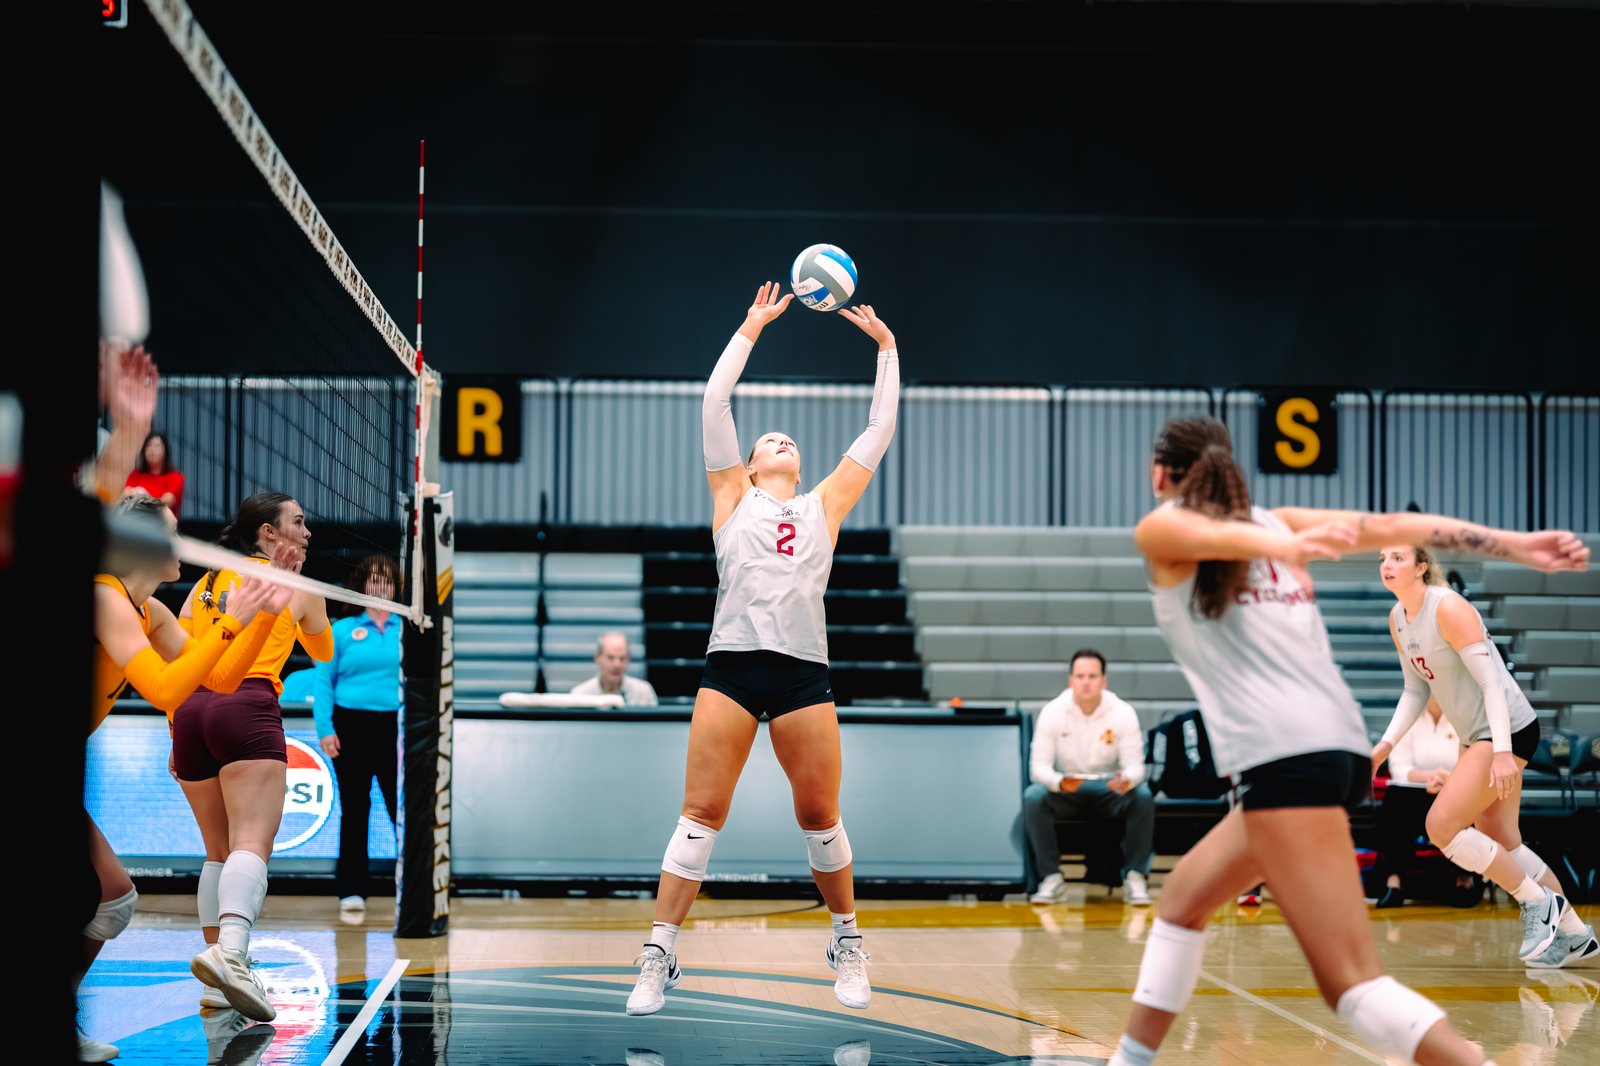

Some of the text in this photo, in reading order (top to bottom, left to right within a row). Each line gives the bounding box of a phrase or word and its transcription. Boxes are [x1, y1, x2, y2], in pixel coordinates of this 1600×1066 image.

[457, 387, 503, 456] R
[1275, 397, 1320, 469] S
[777, 523, 796, 556] 2
[286, 782, 323, 804] SI
